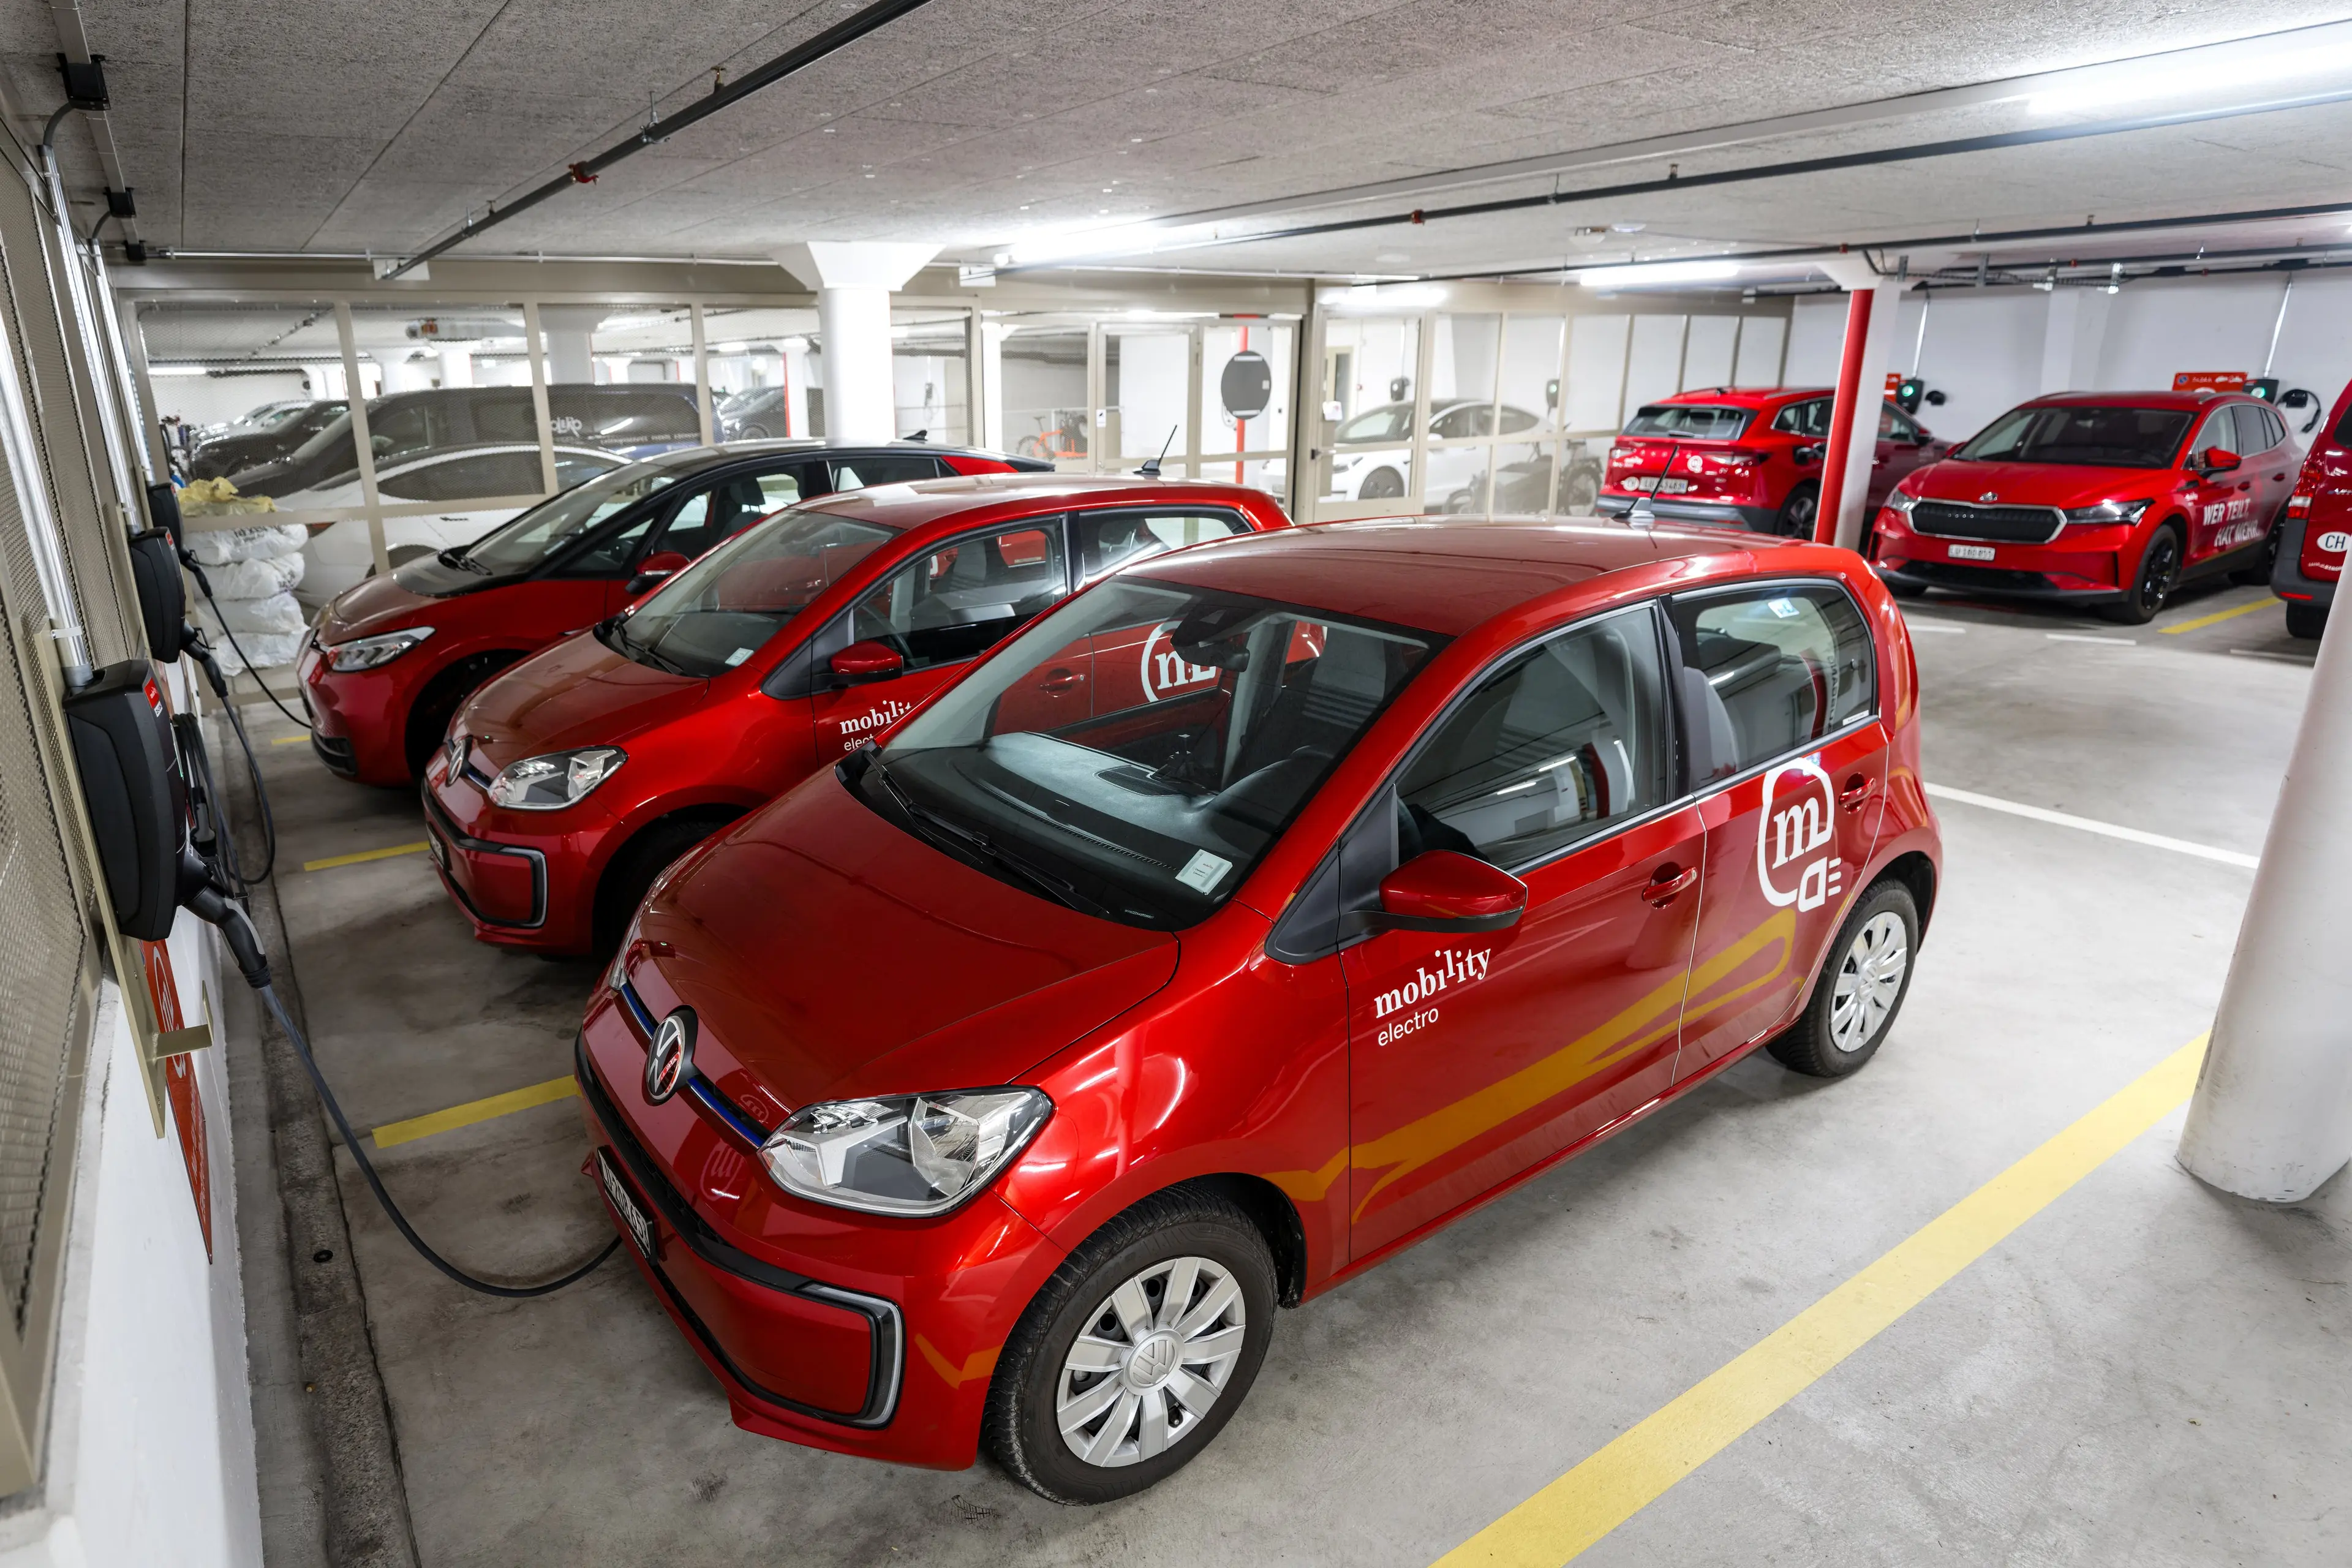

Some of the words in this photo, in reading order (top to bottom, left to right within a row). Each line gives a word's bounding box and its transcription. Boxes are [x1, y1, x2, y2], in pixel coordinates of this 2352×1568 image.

[2203, 503, 2225, 526] WER
[2214, 525, 2235, 547] HAT
[2325, 535, 2346, 549] CH
[1374, 948, 1491, 1018] mobility
[1378, 1008, 1439, 1046] electro
